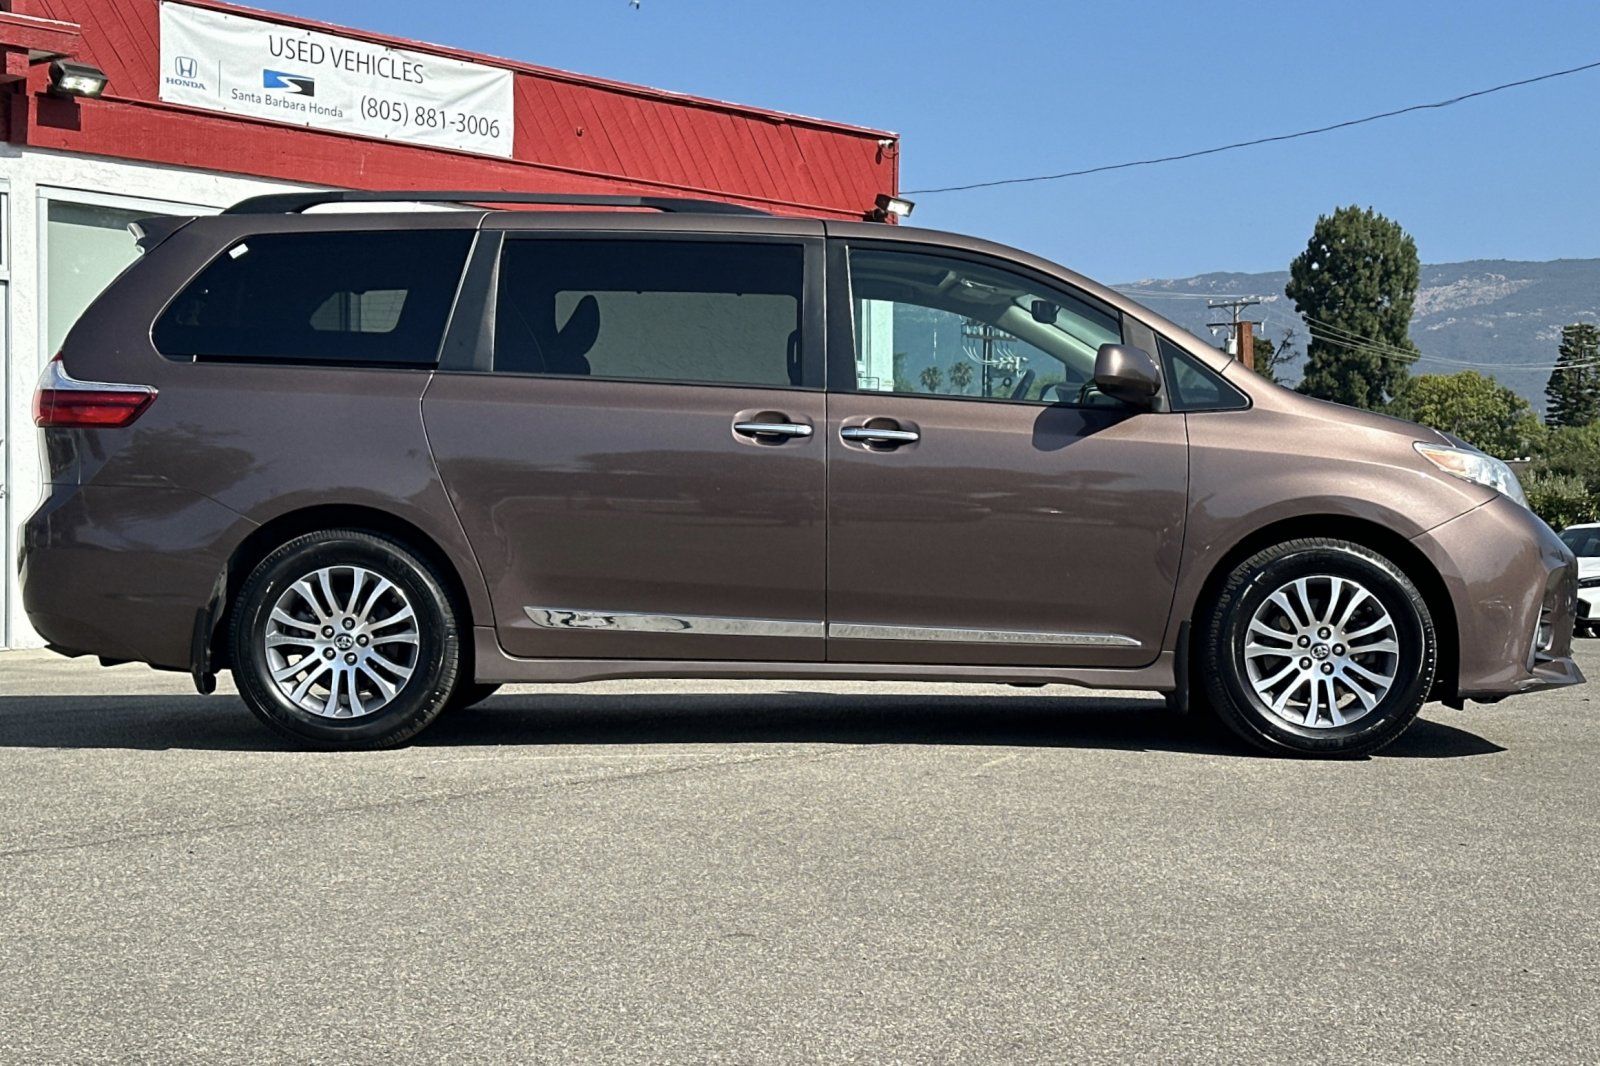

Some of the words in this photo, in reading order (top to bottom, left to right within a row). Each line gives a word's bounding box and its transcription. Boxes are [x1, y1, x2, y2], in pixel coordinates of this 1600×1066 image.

[268, 35, 324, 65] USED
[330, 47, 424, 84] VEHICLES
[165, 77, 206, 91] HONDA
[231, 88, 262, 104] Santa
[265, 94, 307, 112] Barbara
[309, 102, 343, 118] Honda
[360, 95, 409, 127] (805)
[414, 107, 500, 139] 881-3006
